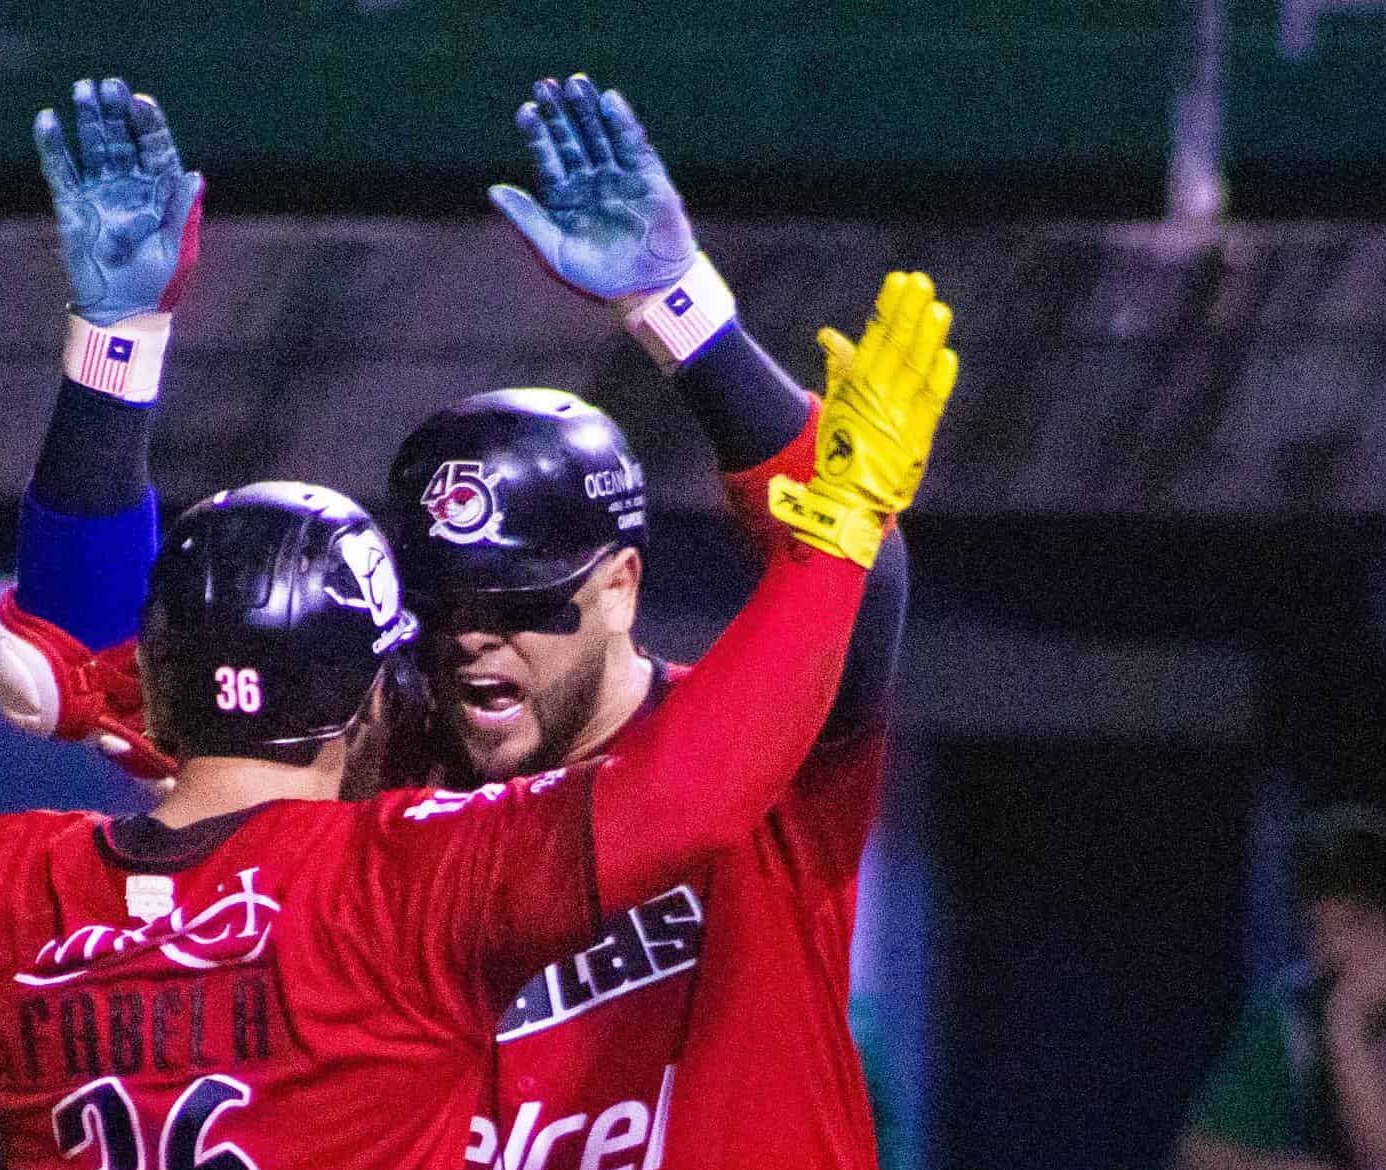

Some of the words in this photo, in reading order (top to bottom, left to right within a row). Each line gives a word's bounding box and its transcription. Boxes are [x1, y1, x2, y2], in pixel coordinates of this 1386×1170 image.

[421, 461, 482, 505] 45
[214, 666, 262, 713] 36
[19, 976, 269, 1080] FABELA
